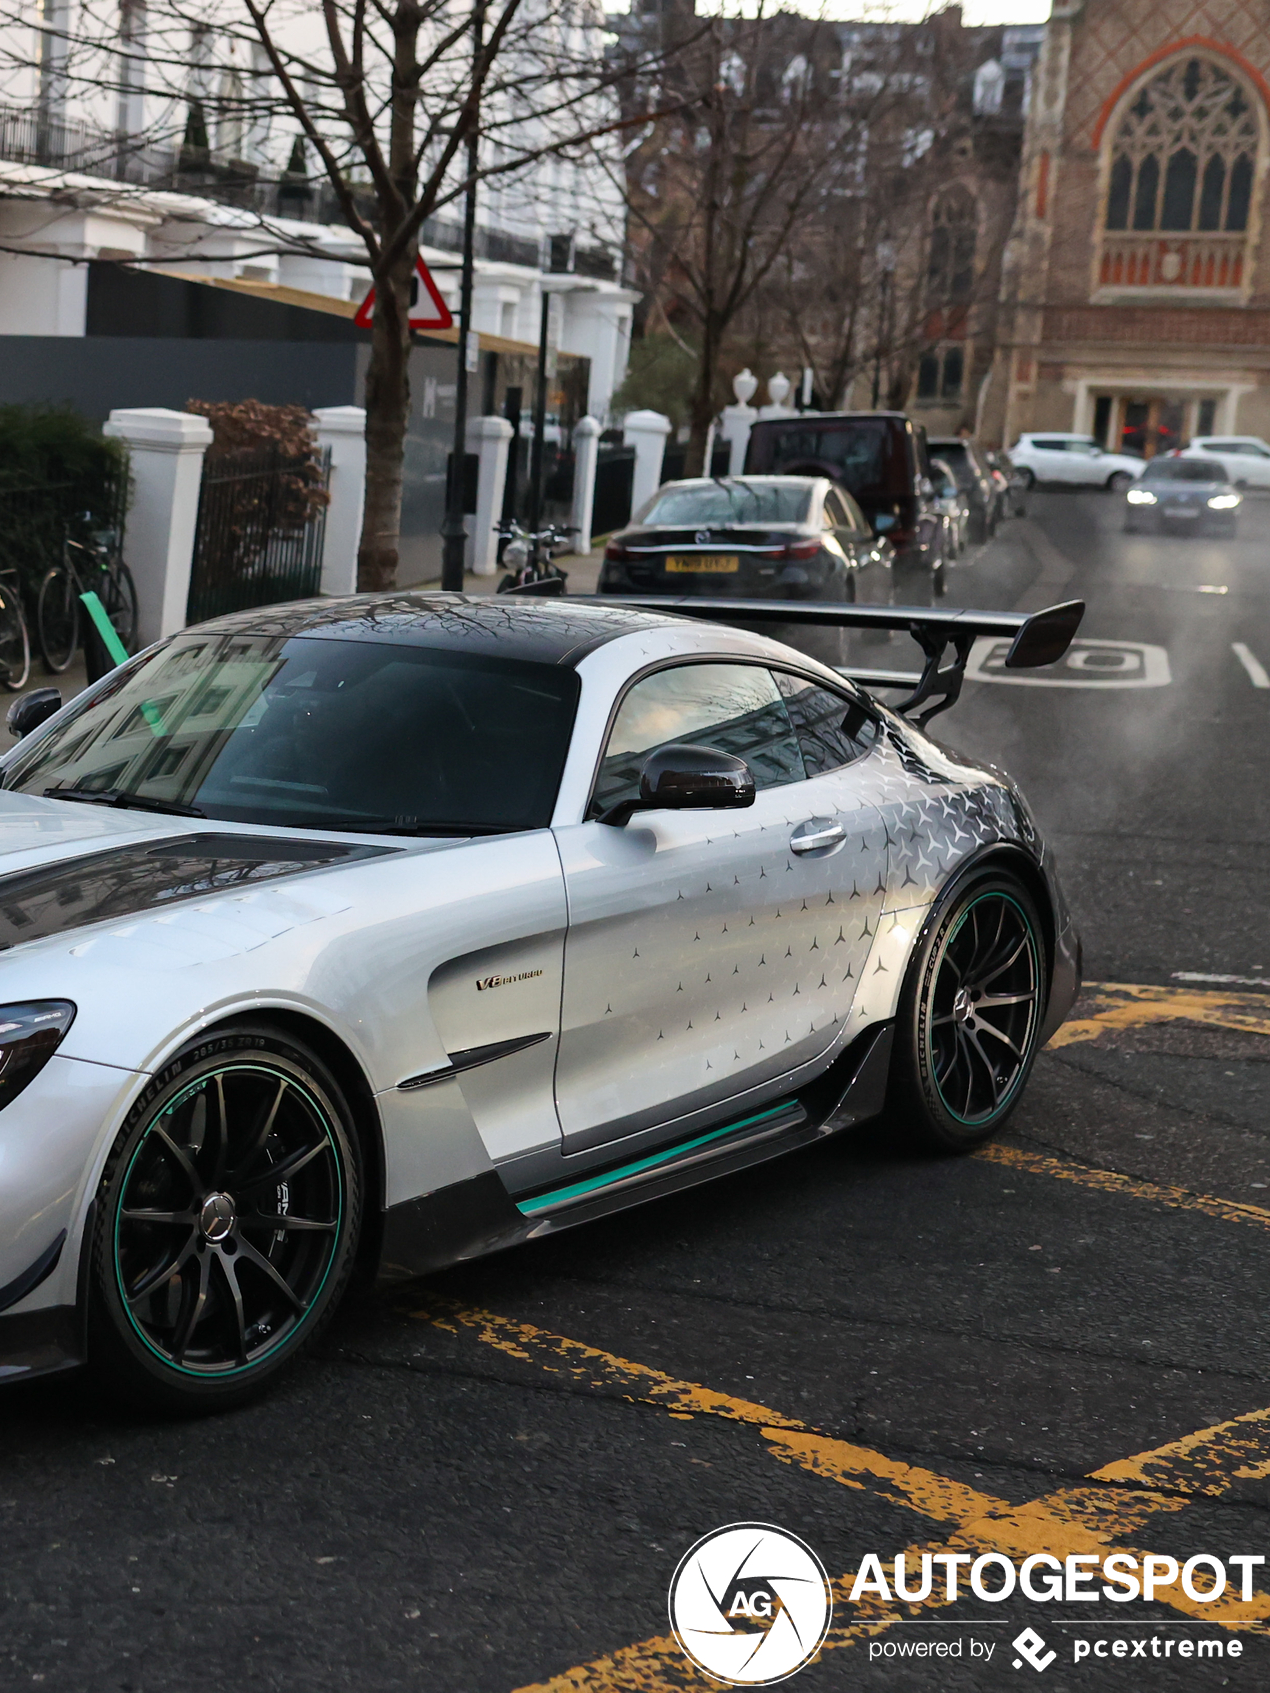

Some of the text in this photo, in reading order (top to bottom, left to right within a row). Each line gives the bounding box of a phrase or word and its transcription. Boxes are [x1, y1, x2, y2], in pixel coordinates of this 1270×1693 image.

[476, 975, 502, 991] V8
[919, 1001, 928, 1078] MICHELIN
[114, 1060, 183, 1153] MICHELIN
